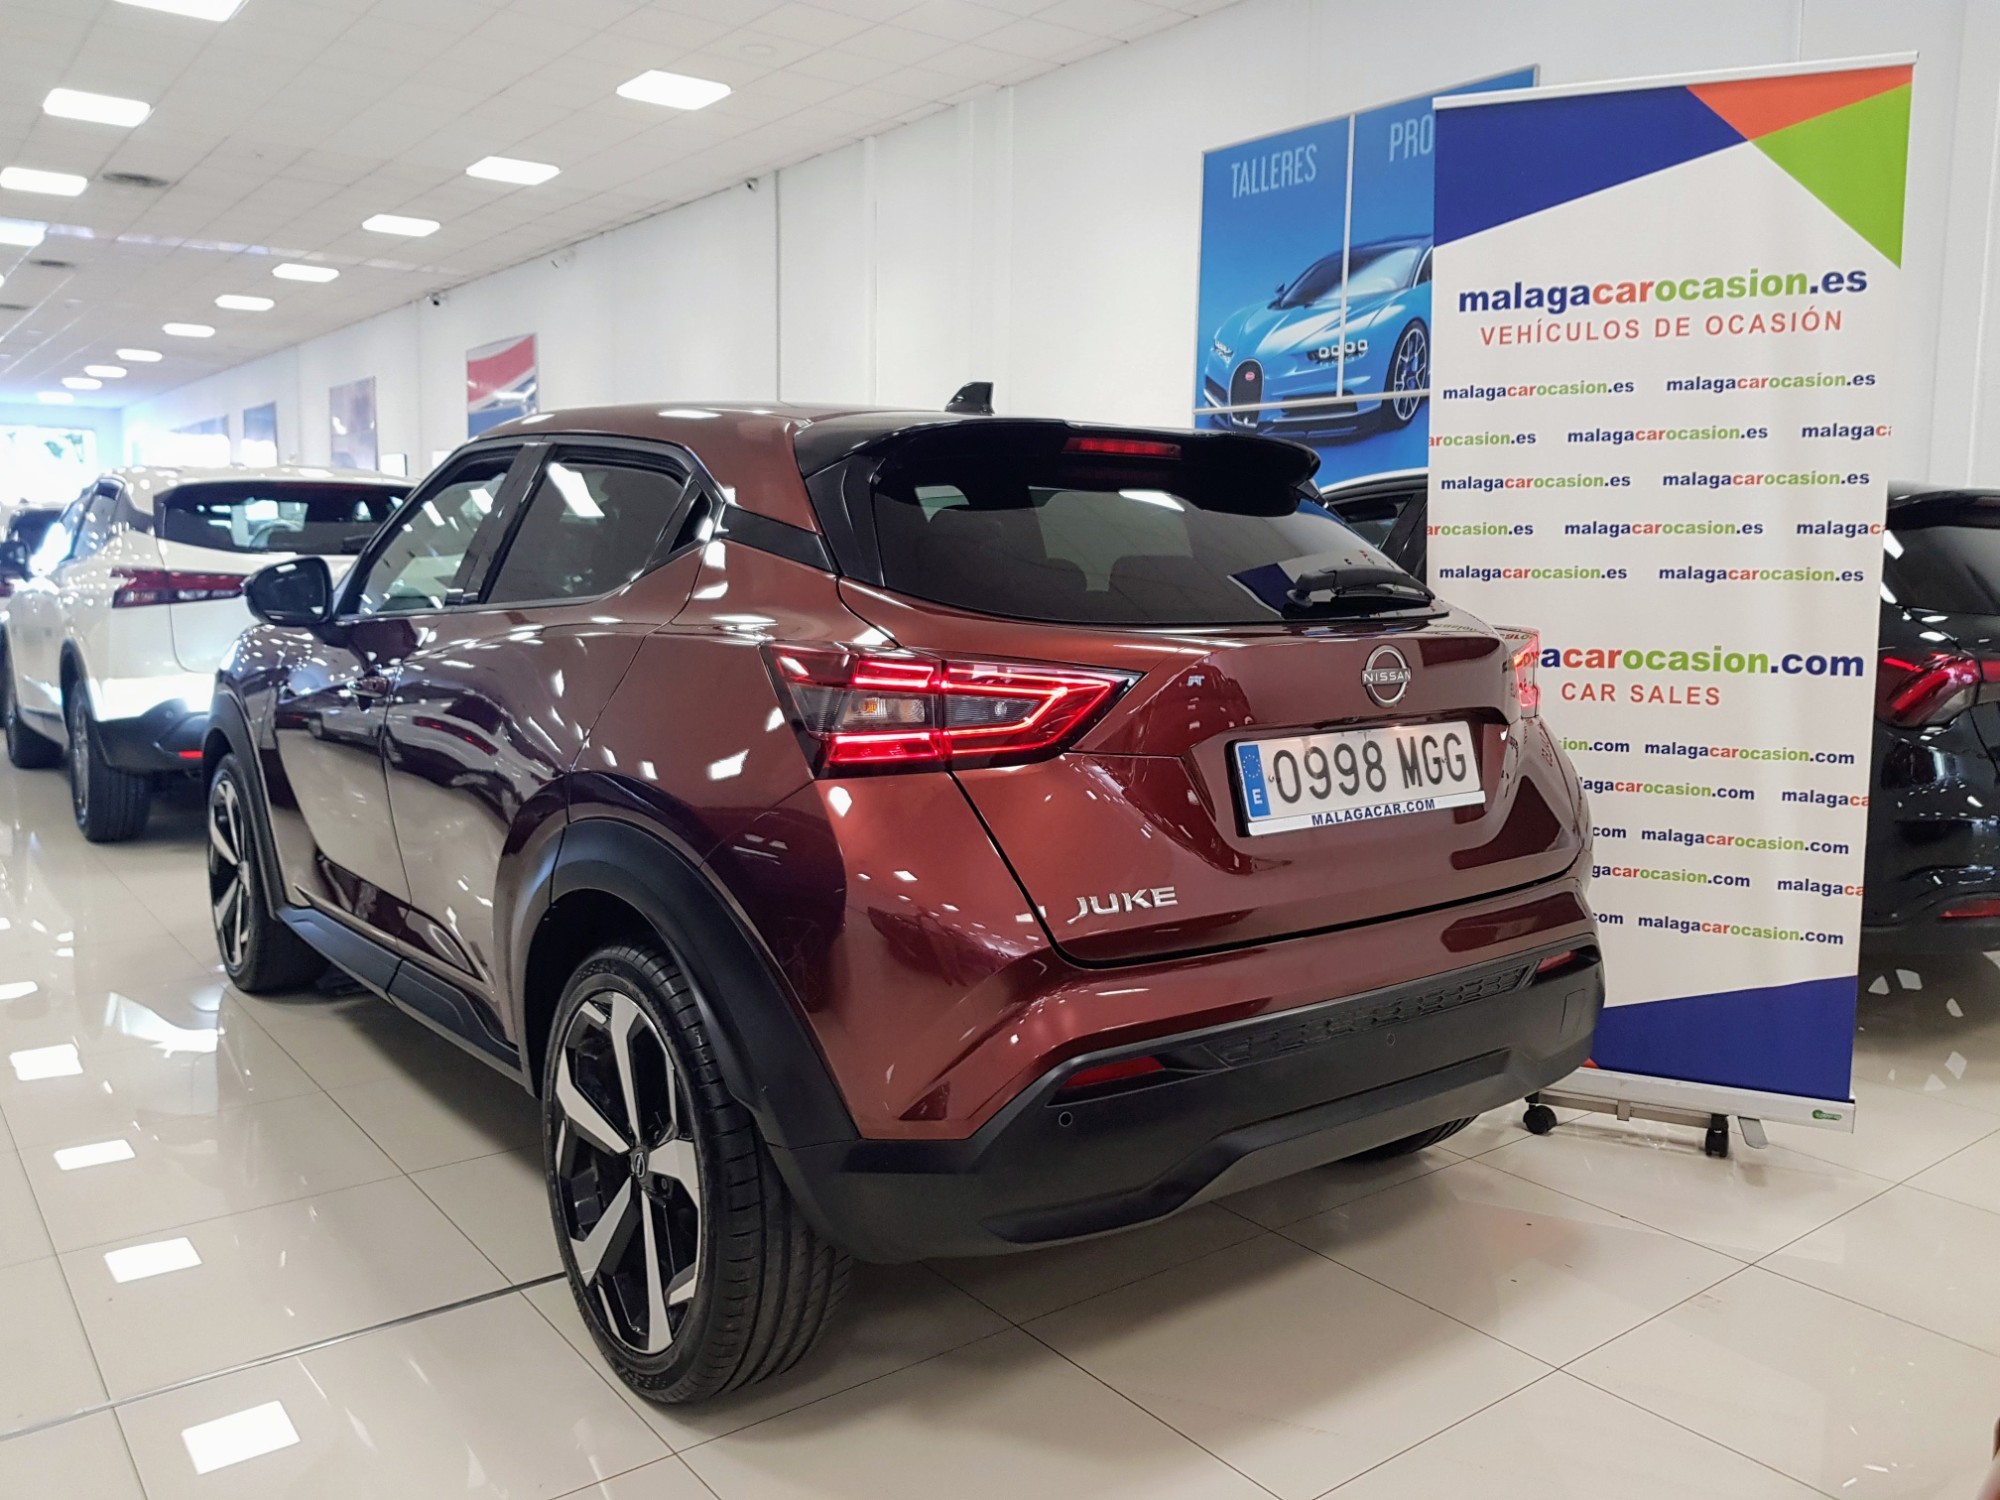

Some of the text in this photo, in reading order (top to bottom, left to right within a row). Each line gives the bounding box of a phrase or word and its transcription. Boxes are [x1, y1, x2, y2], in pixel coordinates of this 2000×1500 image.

[1389, 113, 1433, 162] PRO
[1231, 143, 1317, 198] TALLERES
[1458, 268, 1868, 314] malagacarocasion.es
[1481, 306, 1841, 345] VEHÍCULOS DE OCASIÓN
[1443, 373, 1875, 401] malagacarocasion.es malagacarocasion.es
[1568, 426, 1767, 445] malagacarocasion.es
[1441, 471, 1869, 492] malagacarocasion.es malagacarocasion.es
[1565, 521, 1763, 538] malagacarocasion.es
[1440, 565, 1863, 583] malagacarocasion.es malagacarocasion.es
[1364, 670, 1410, 682] NISSAN
[1562, 683, 1719, 705] CAR SALES
[1645, 742, 1854, 764] malagacarocasion.com
[1273, 732, 1466, 804] 0998 MGG
[1252, 788, 1263, 804] E
[1580, 776, 1869, 808] agacarocasion.com malagaca
[1311, 799, 1436, 826] MALAGACAR.COM
[1642, 829, 1848, 854] malagacarocasion.com
[1777, 878, 1864, 897] malagaca
[1066, 886, 1178, 924] JUKE
[1638, 916, 1843, 944] malagacarocasion.com
